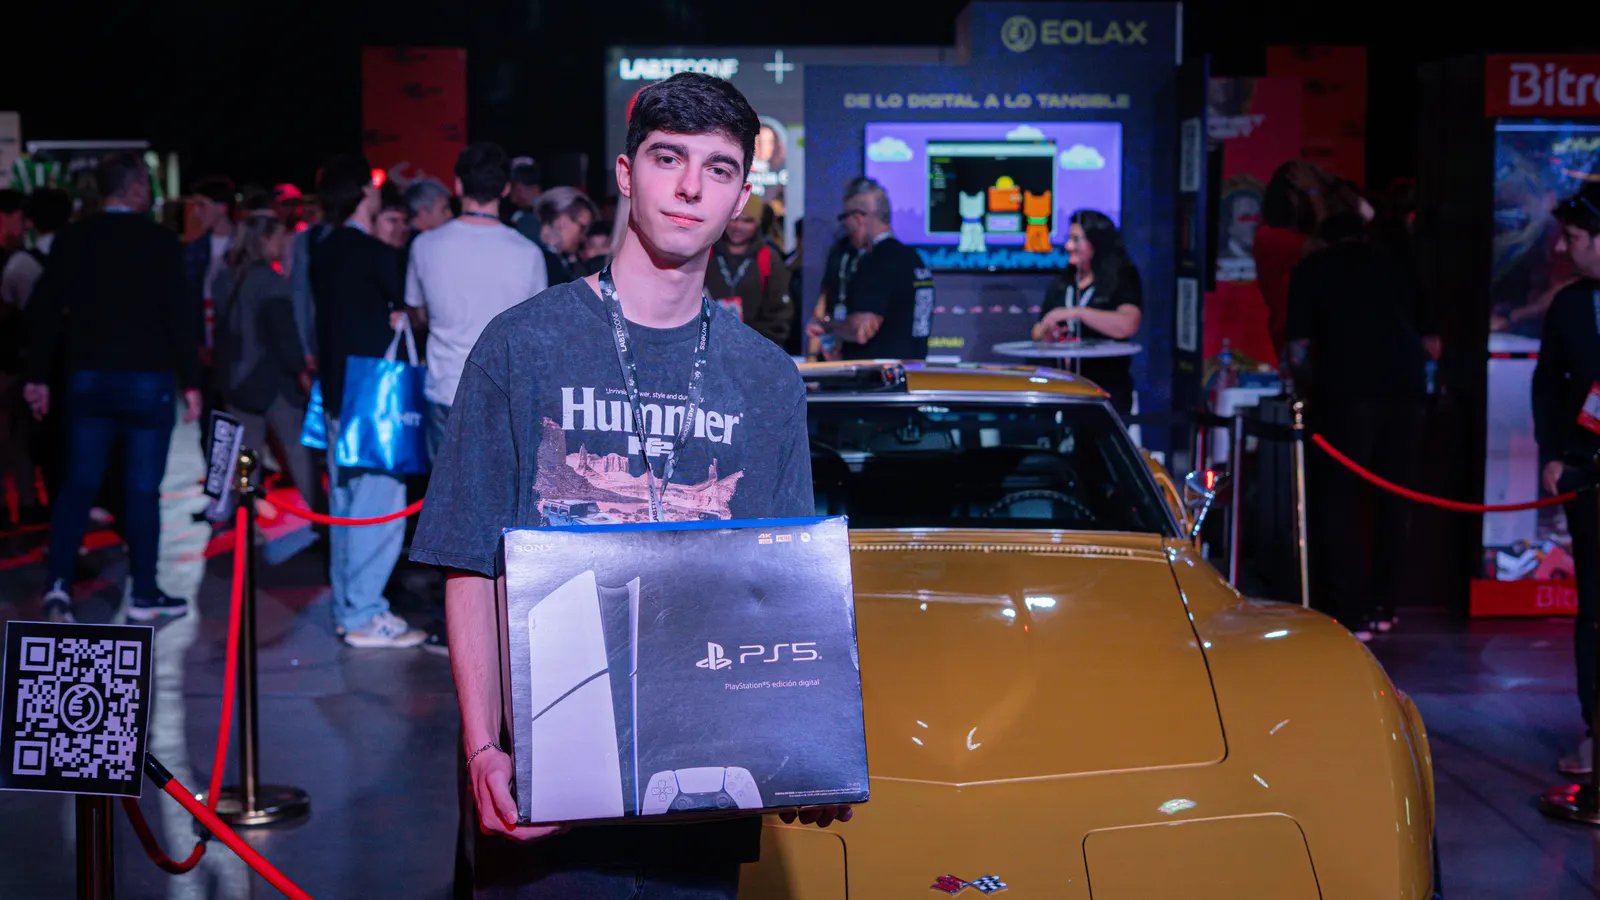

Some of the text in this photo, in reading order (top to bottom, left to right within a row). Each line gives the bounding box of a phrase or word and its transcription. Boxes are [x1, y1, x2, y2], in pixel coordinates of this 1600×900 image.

[1040, 19, 1149, 45] EOLAX
[843, 93, 871, 109] DE
[874, 93, 904, 109] LO
[983, 93, 1000, 109] A
[1003, 93, 1033, 109] LO
[652, 391, 666, 400] style
[561, 386, 741, 446] Hummer
[772, 680, 797, 689] edición
[798, 679, 820, 688] digital
